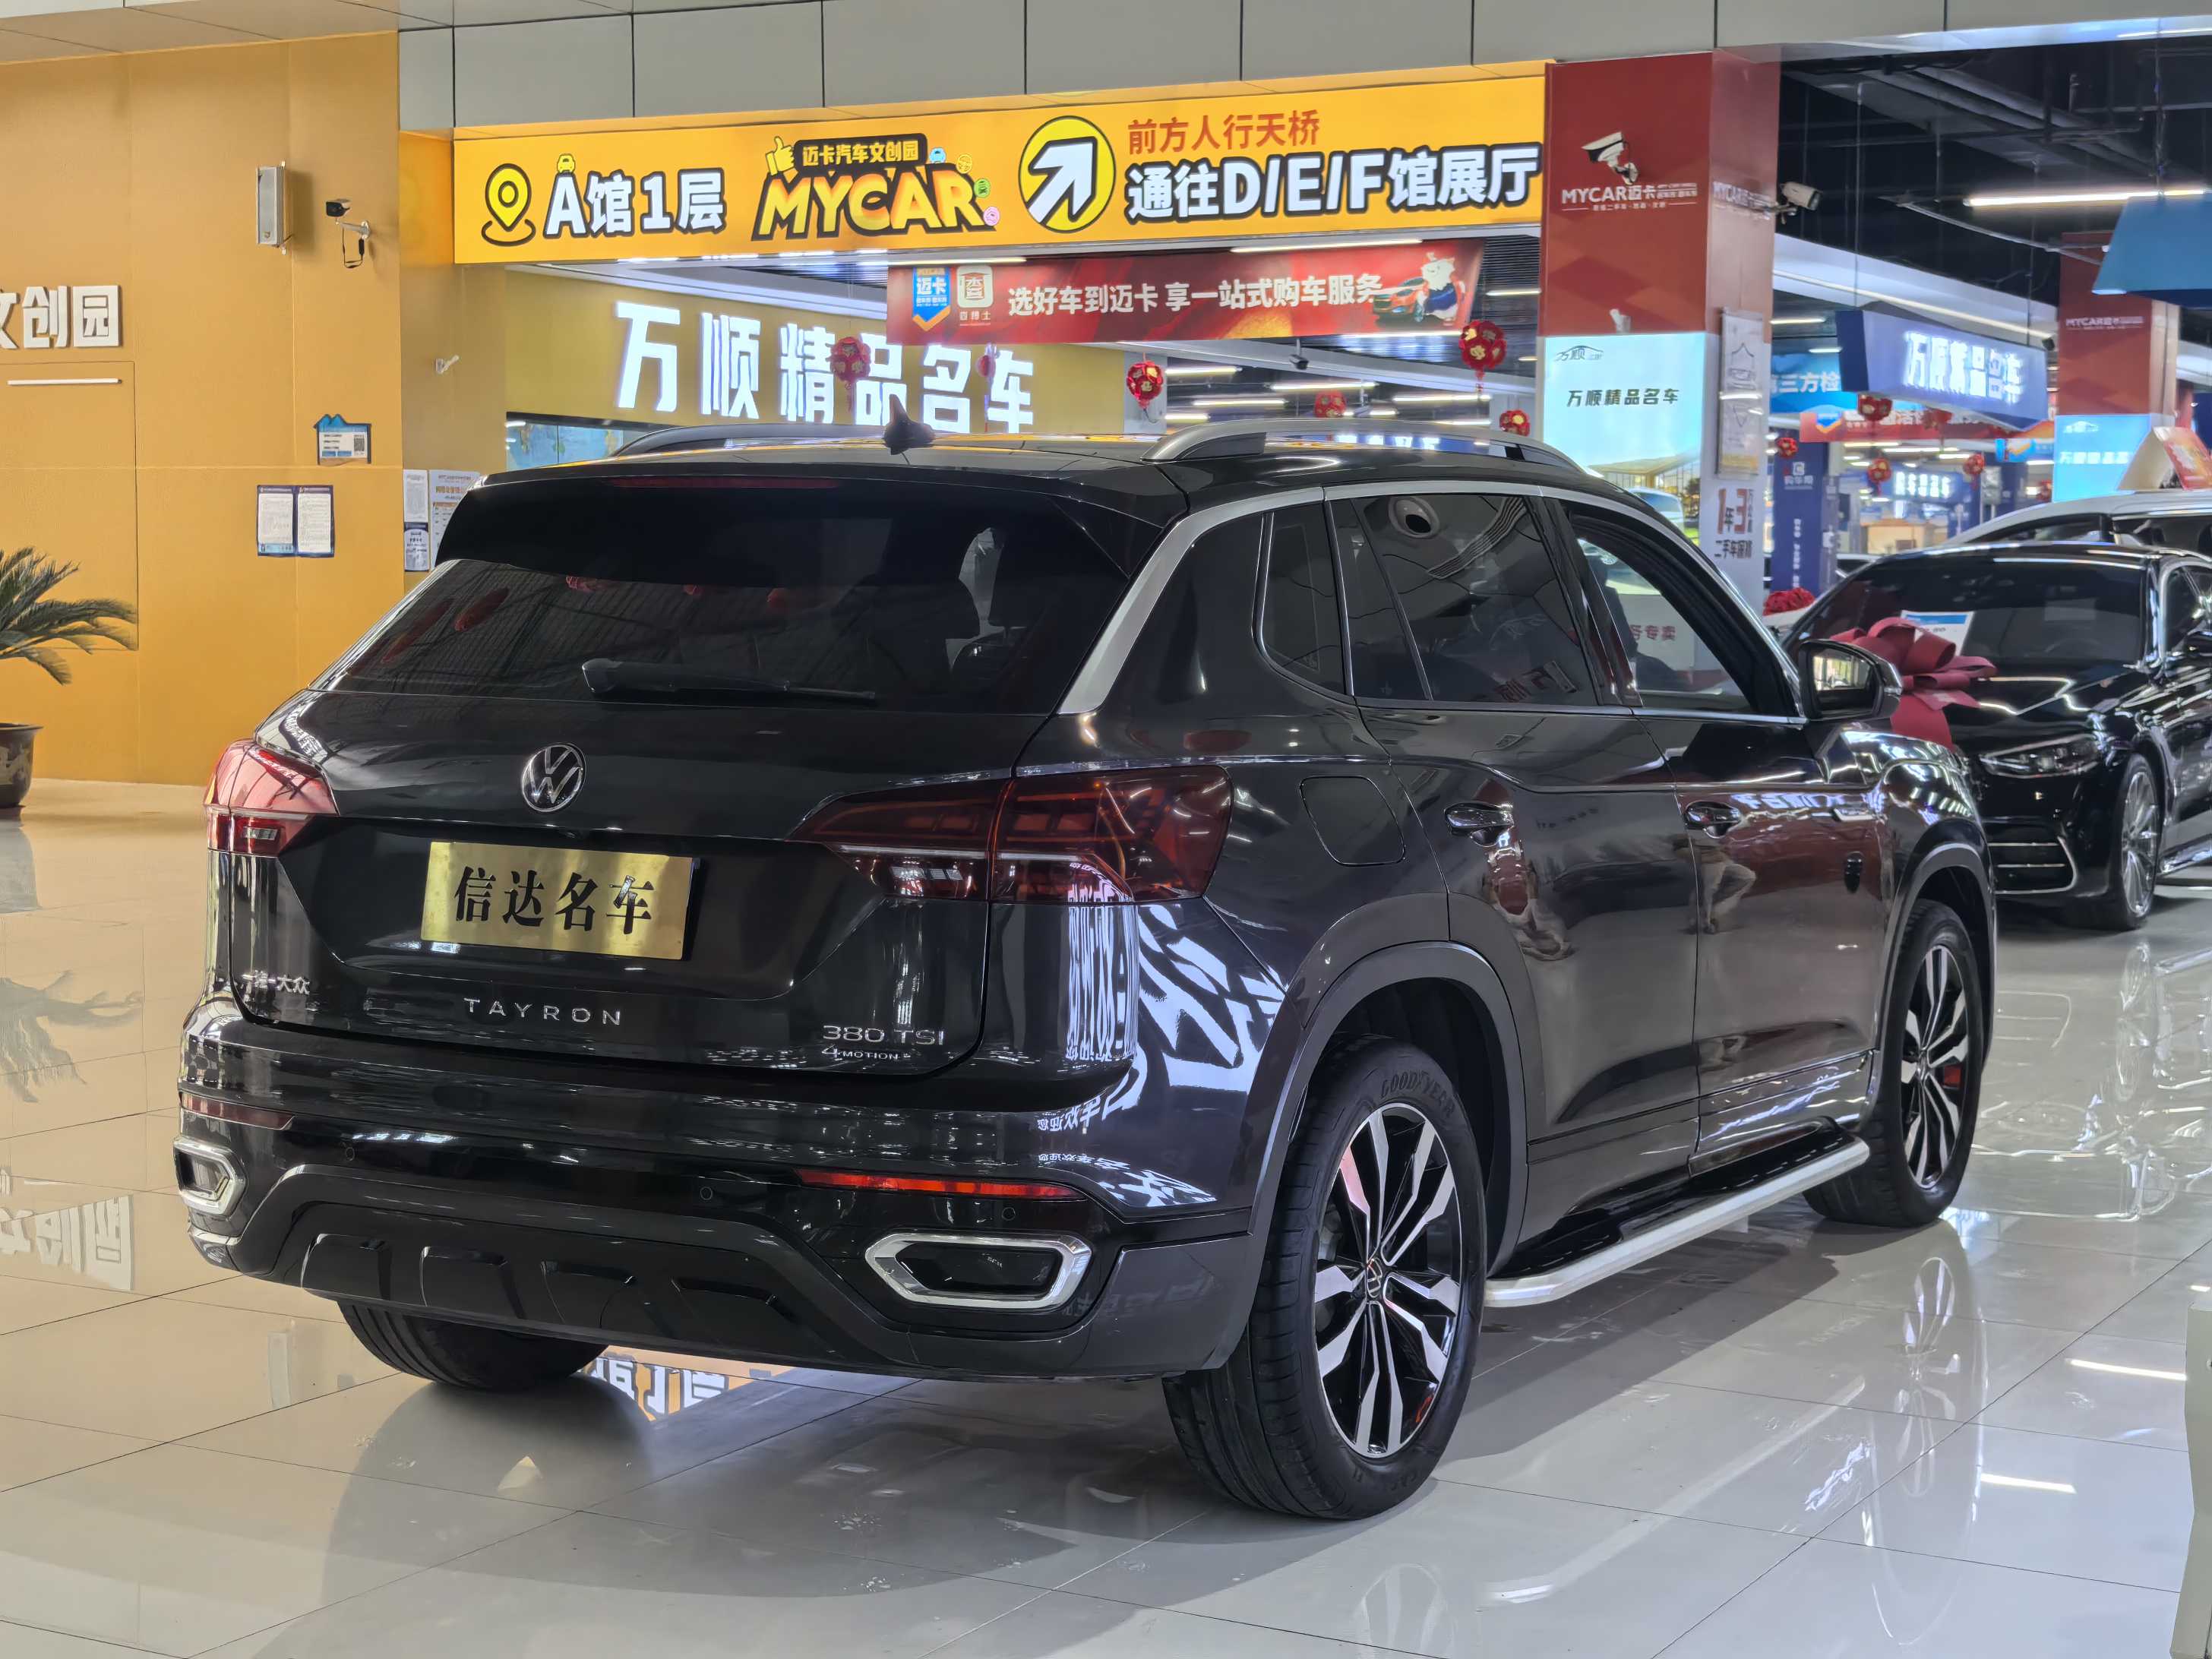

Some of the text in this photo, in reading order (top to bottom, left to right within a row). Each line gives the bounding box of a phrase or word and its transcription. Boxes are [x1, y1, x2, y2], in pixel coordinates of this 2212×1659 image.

[801, 140, 919, 166] 迈卡汽车文创园
[1128, 109, 1320, 155] 前方人行天桥
[543, 169, 726, 238] A馆1层
[754, 166, 990, 239] MYCAR
[1127, 144, 1541, 221] 通往D/E/F馆展厅
[916, 276, 947, 295] 迈卡
[1008, 273, 1383, 317] 选好车到迈卡 享一站式购车服务
[615, 301, 1034, 434] 万顺精品名车
[1566, 387, 1680, 408] 万顺精品名车
[454, 864, 655, 935] 信达名车
[463, 997, 621, 1025] TAYRON
[821, 1044, 899, 1060] 4MOTION
[822, 1025, 945, 1046] 380 TSI
[1381, 1070, 1455, 1119] GOODYEAR
